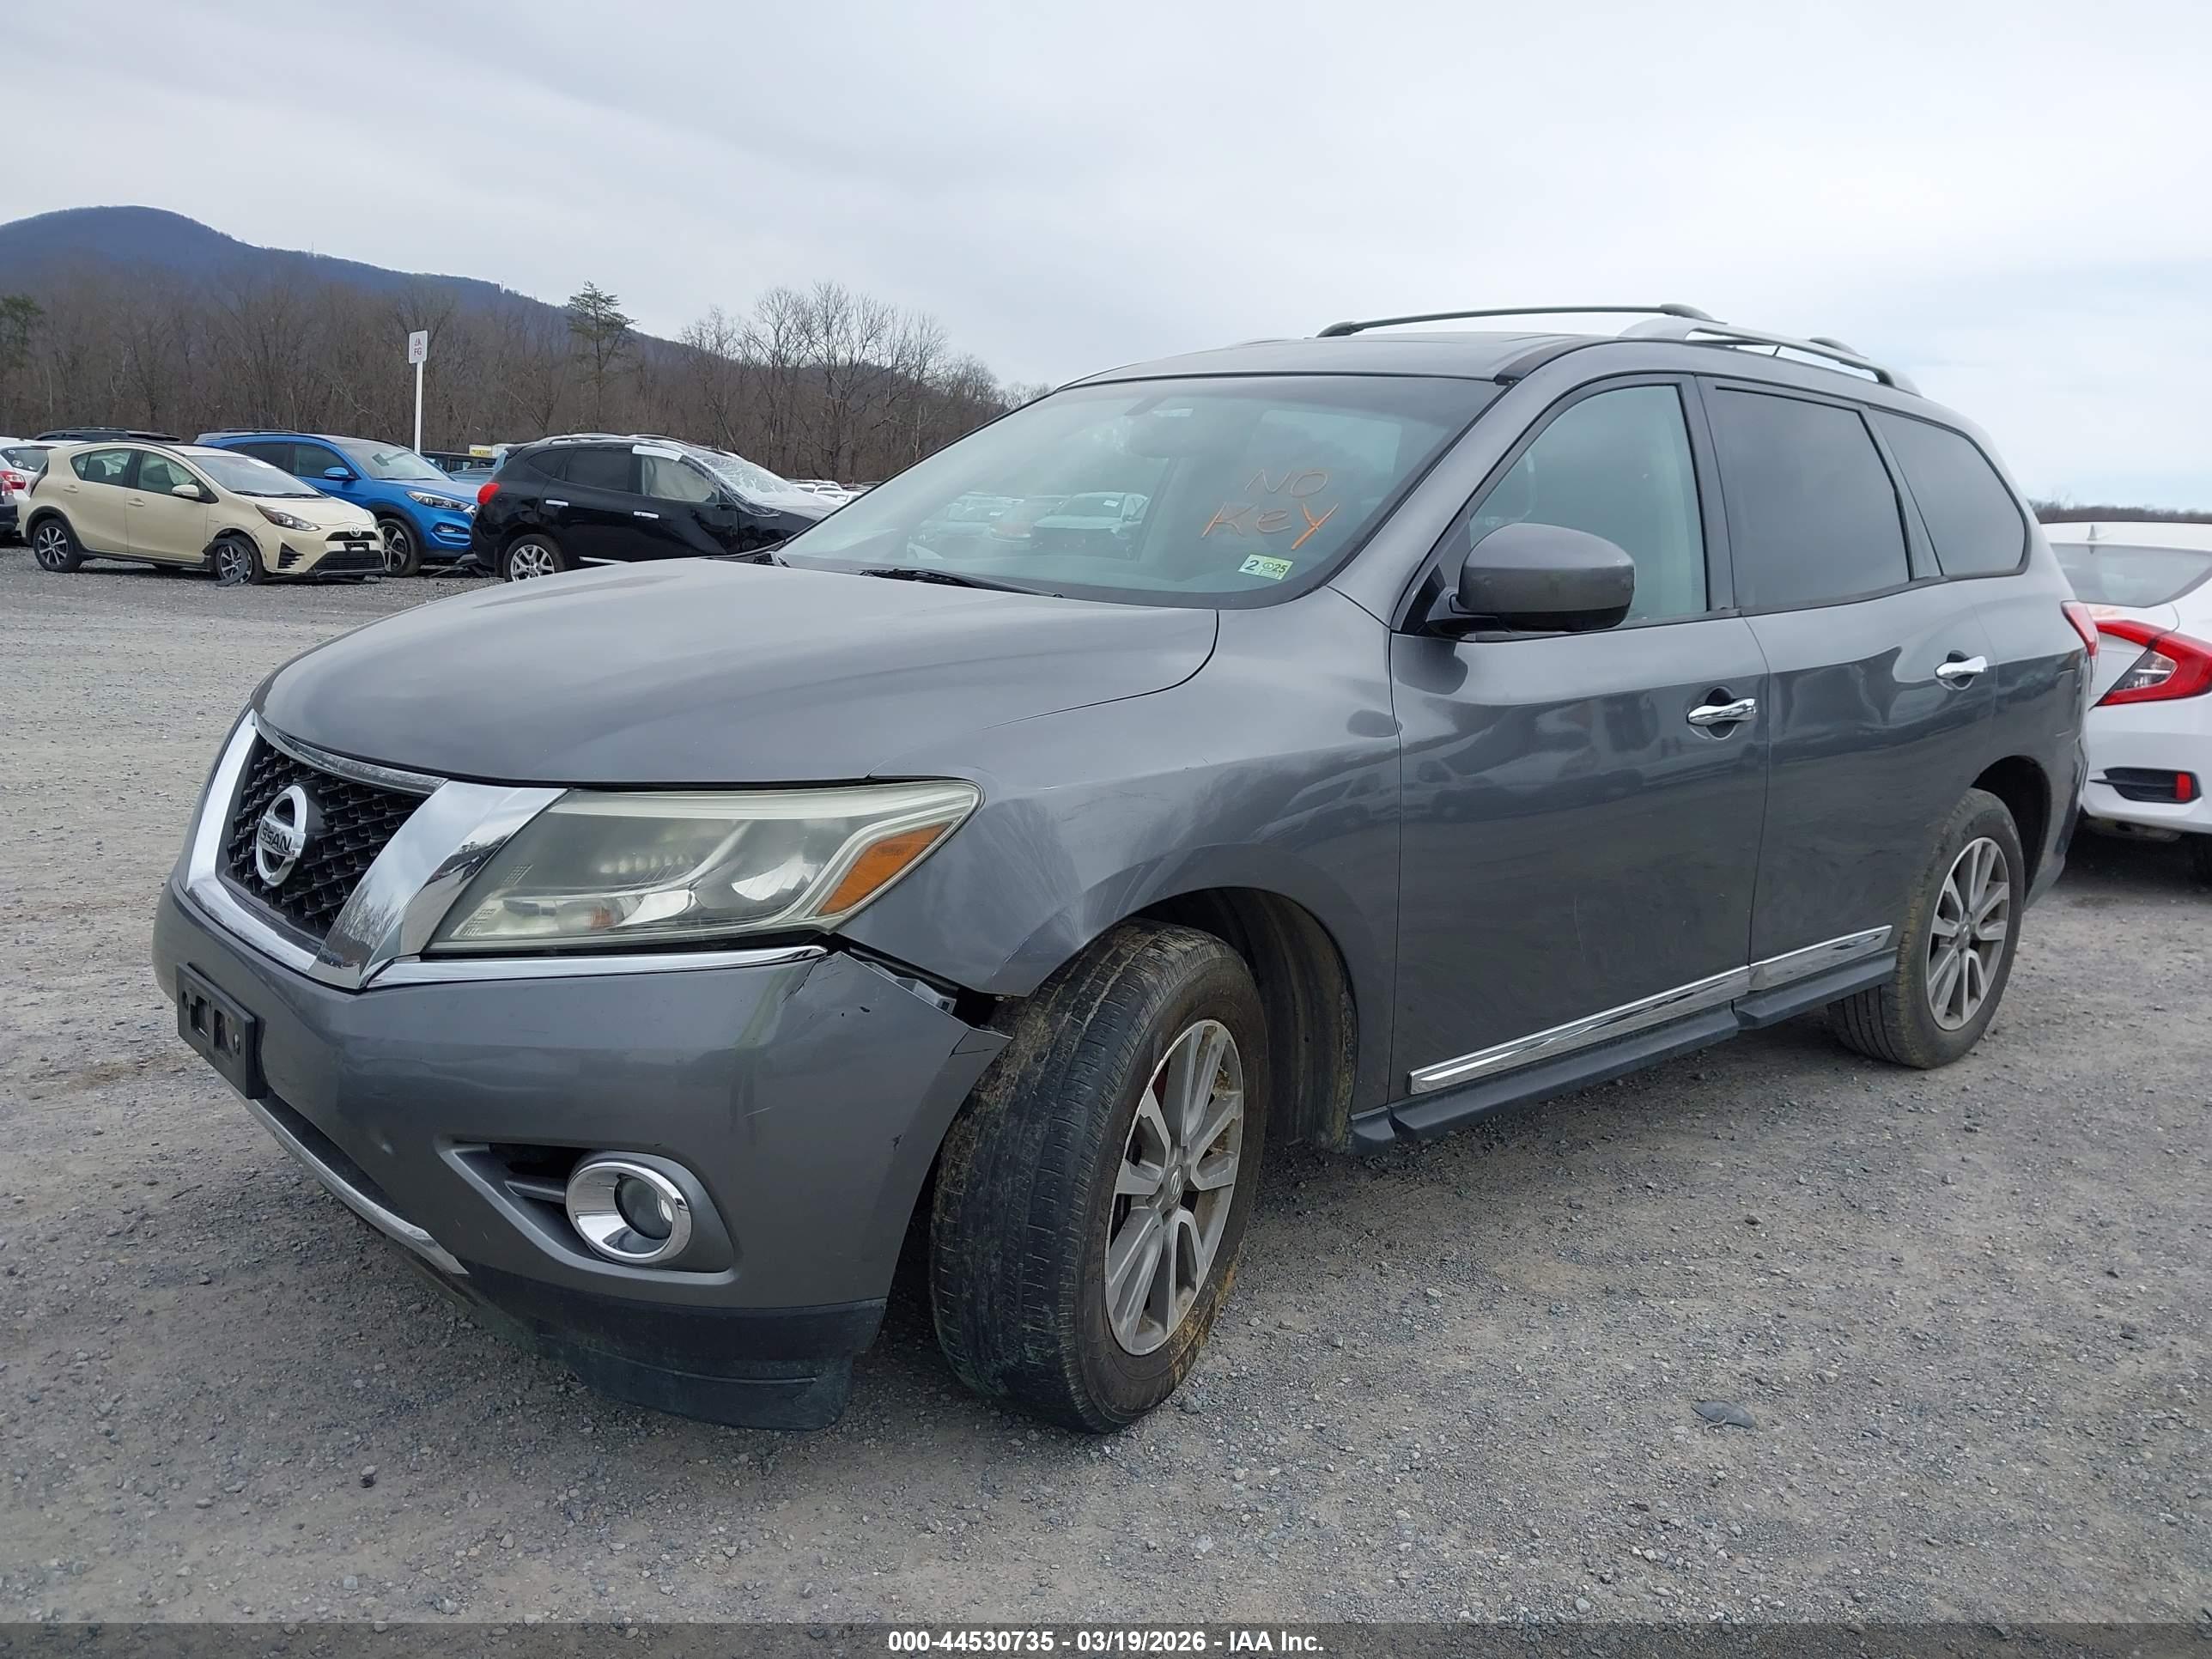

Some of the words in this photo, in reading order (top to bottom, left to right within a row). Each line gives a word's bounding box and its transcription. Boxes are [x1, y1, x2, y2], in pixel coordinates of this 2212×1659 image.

[1243, 468, 1328, 498] NO
[1245, 559, 1260, 571] 2
[1273, 563, 1288, 574] 25
[259, 827, 293, 852] SSAN
